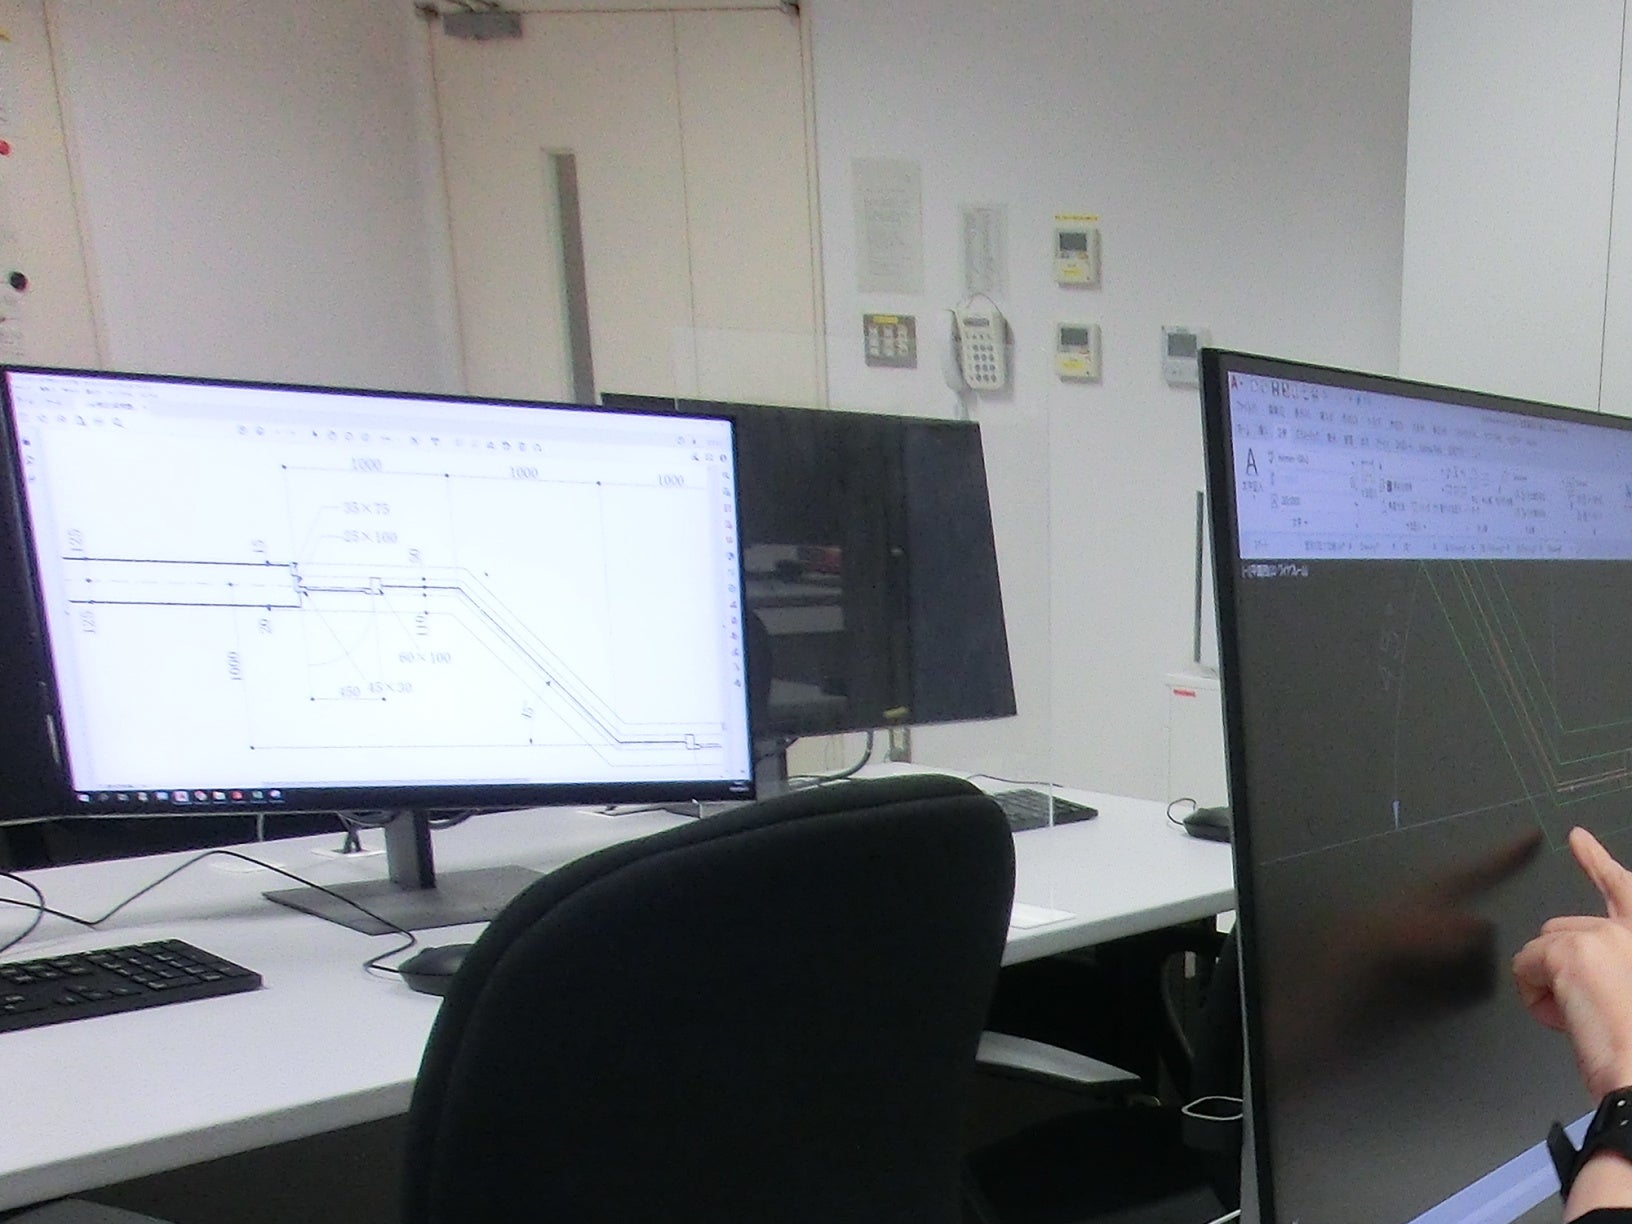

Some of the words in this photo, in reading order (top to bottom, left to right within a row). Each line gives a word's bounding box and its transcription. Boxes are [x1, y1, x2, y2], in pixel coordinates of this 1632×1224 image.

[1246, 448, 1259, 476] A
[510, 466, 539, 480] 1000
[657, 473, 685, 487] 1000
